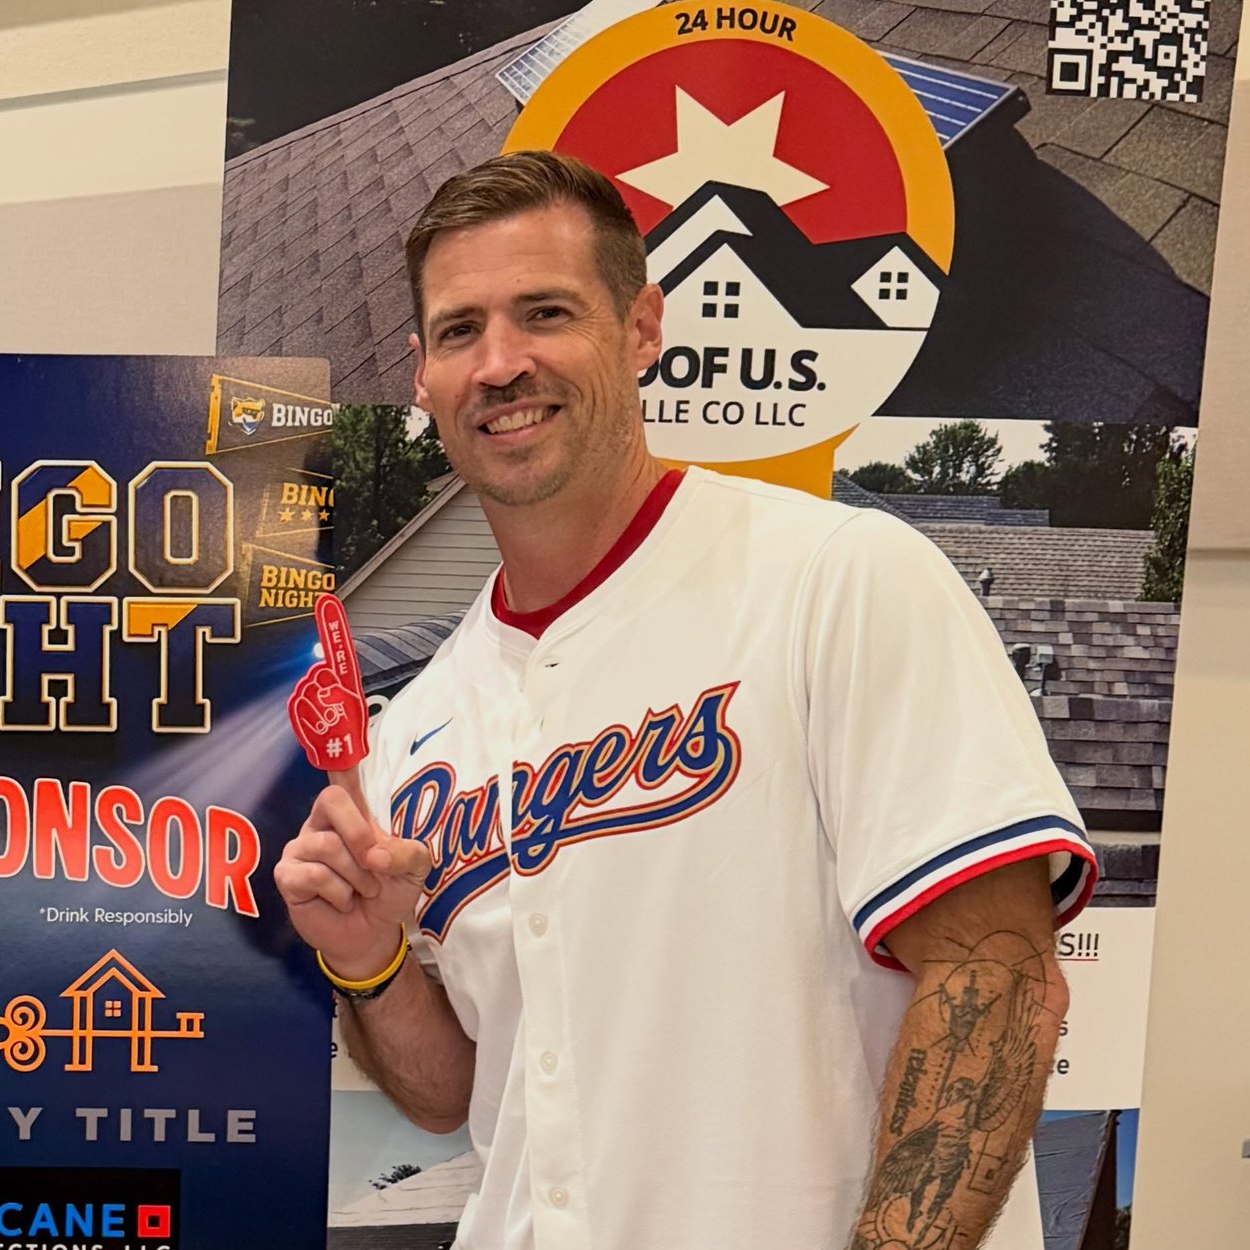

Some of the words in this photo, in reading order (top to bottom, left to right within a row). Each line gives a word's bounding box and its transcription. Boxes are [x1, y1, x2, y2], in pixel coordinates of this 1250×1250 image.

[675, 9, 708, 35] 24
[716, 7, 797, 42] HOUR
[638, 346, 729, 388] OF
[740, 347, 826, 391] U.S.
[271, 403, 333, 427] BINGO
[642, 399, 690, 423] LLE
[702, 401, 744, 425] CO
[755, 402, 806, 426] LLC
[260, 564, 335, 591] BINGO
[326, 733, 354, 759] #1
[391, 681, 742, 897] Rangers
[94, 908, 193, 927] Responsibly
[75, 1107, 257, 1143] TITLE
